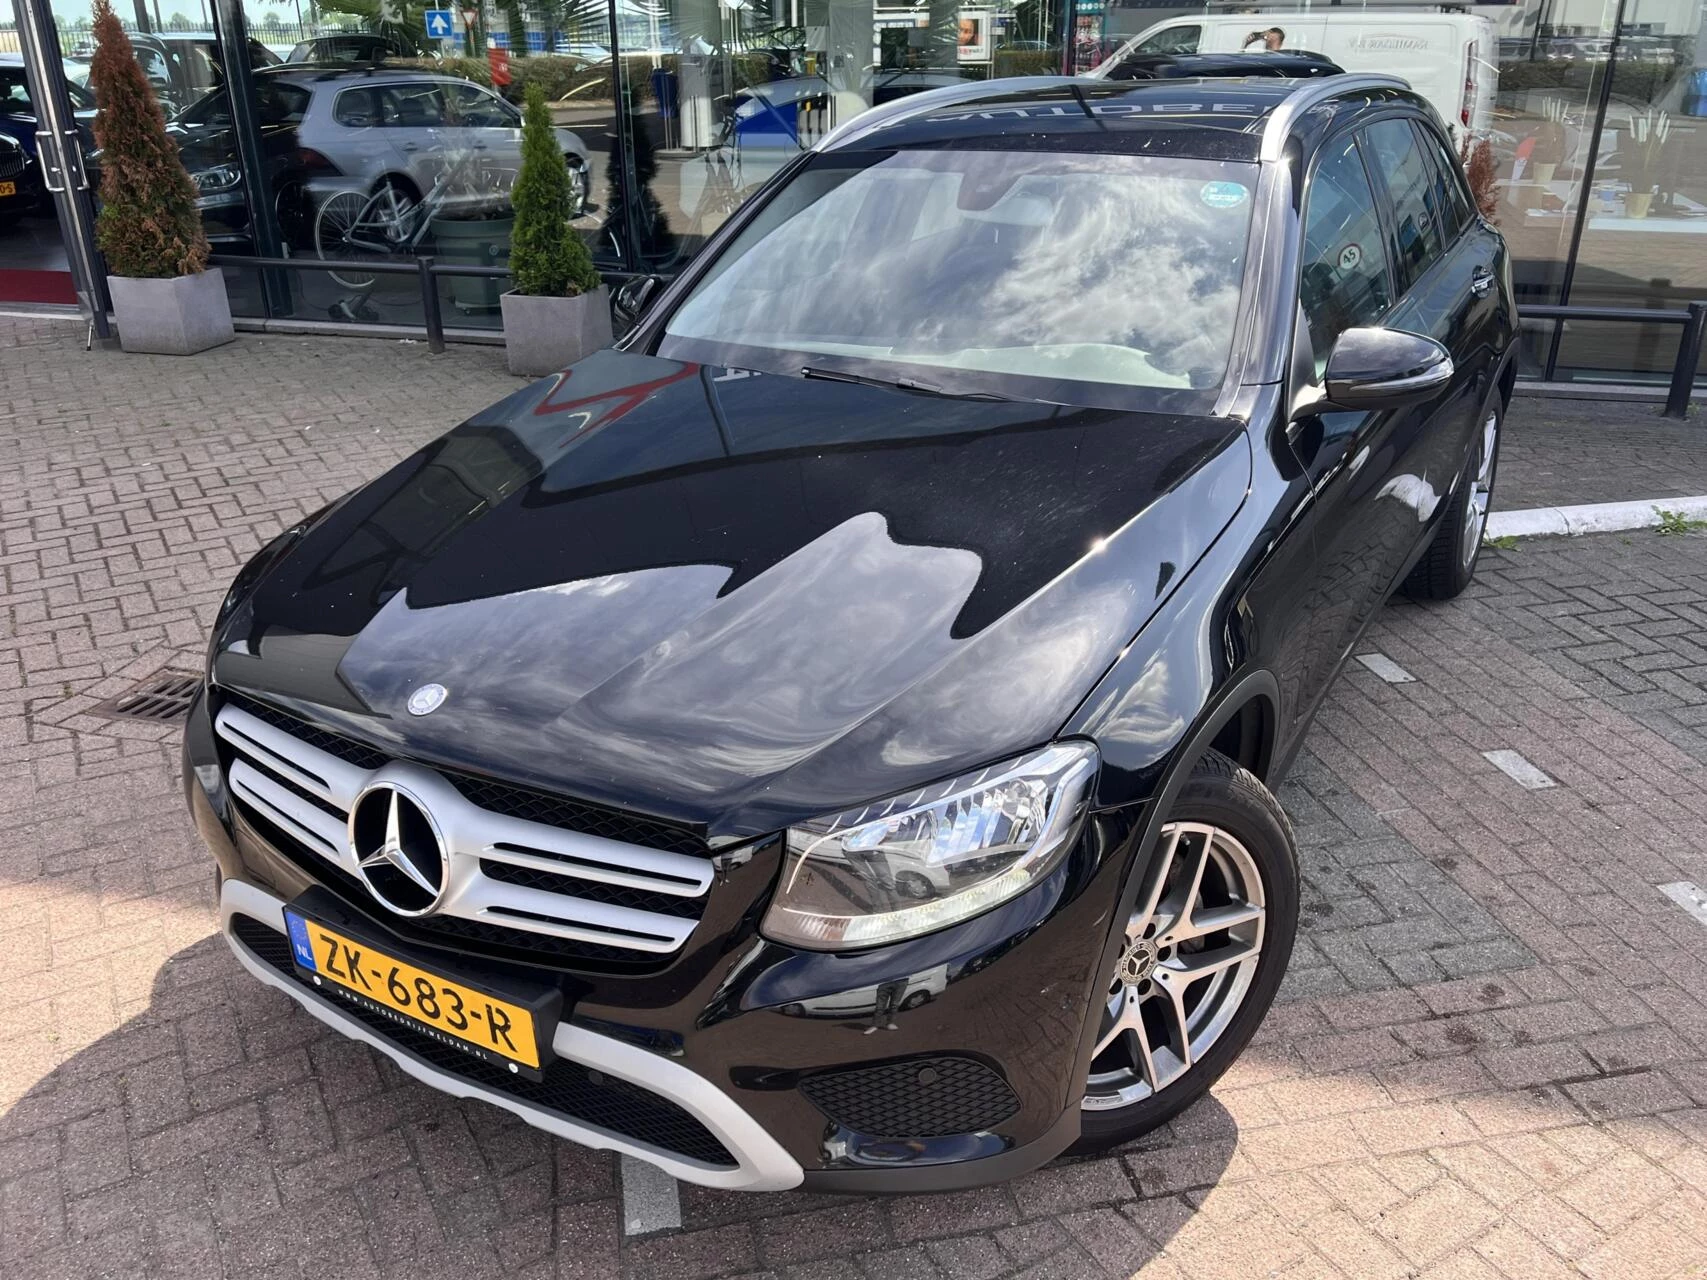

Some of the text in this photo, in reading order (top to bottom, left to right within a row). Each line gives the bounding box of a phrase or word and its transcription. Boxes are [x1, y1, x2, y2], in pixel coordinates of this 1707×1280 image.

[1343, 249, 1356, 264] 45
[296, 944, 312, 960] NL
[319, 933, 518, 1053] ZK-683-R
